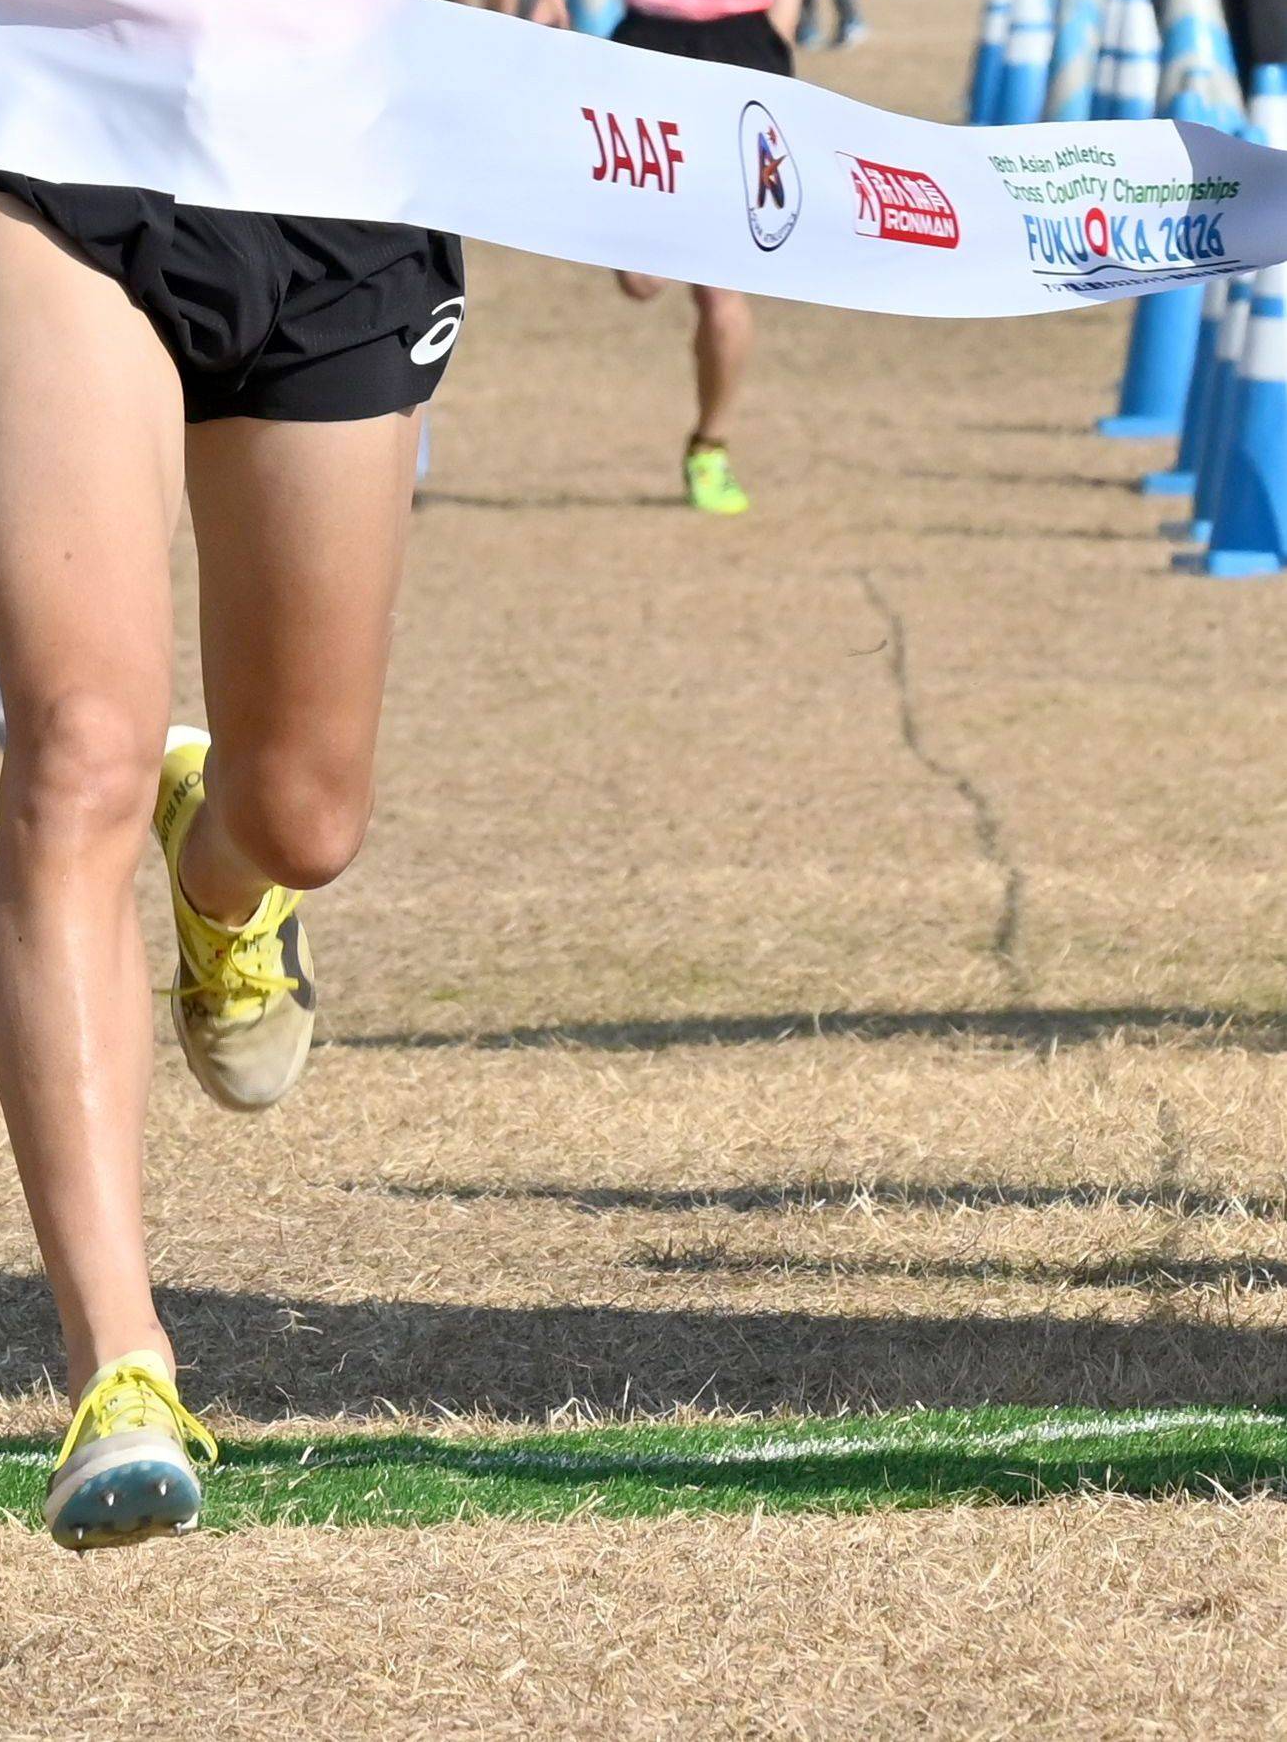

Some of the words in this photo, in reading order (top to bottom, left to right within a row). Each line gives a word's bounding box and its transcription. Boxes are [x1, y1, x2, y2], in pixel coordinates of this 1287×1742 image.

[581, 107, 684, 194] JAAF
[988, 154, 1018, 173] 18th
[1020, 154, 1055, 173] Asian
[1055, 144, 1117, 168] Athletics
[1003, 179, 1045, 203] Cross
[1046, 174, 1109, 204] Country
[1113, 175, 1242, 208] Championships
[1022, 207, 1159, 265] FUKUOKA
[1158, 212, 1226, 261] 2026
